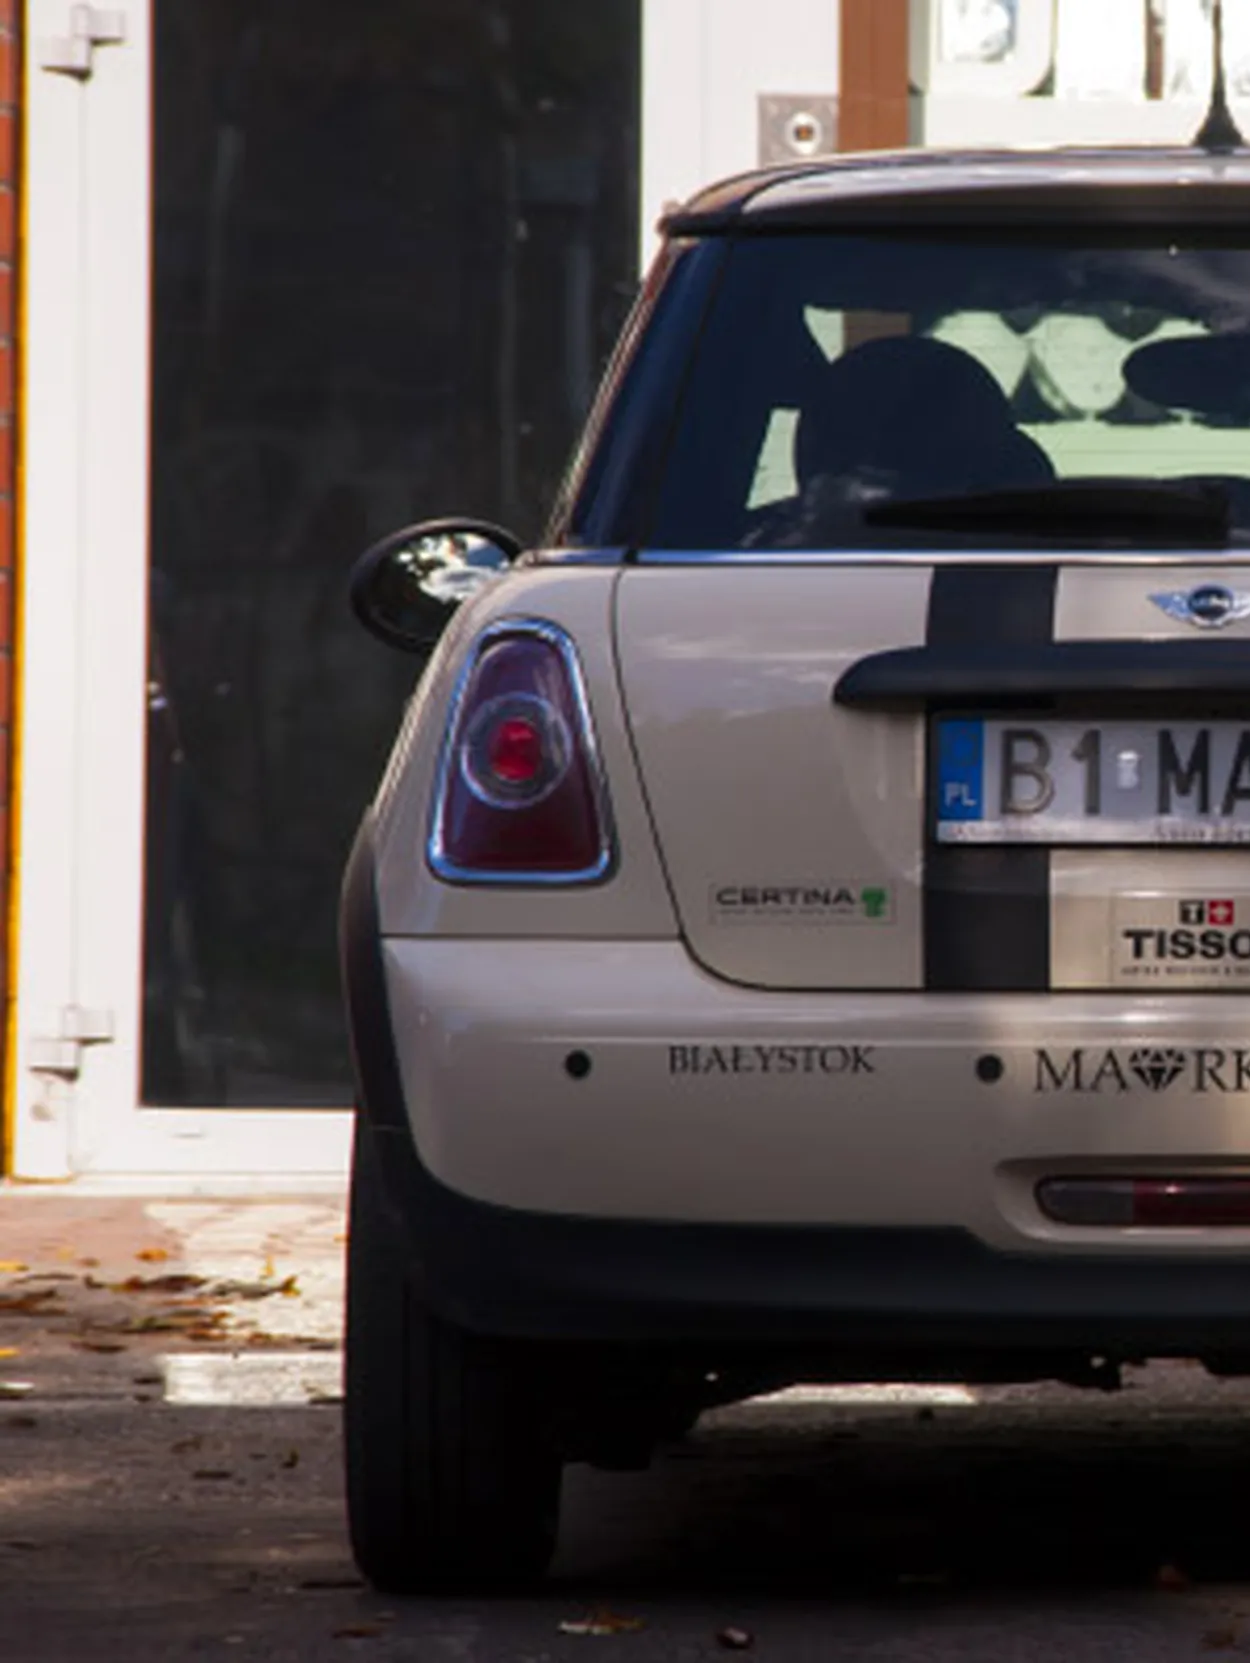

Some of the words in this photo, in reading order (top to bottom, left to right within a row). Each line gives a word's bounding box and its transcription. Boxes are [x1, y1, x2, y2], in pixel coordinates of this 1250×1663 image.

[1002, 728, 1101, 815] B1
[945, 783, 976, 806] PL
[716, 887, 856, 906] CERTINA
